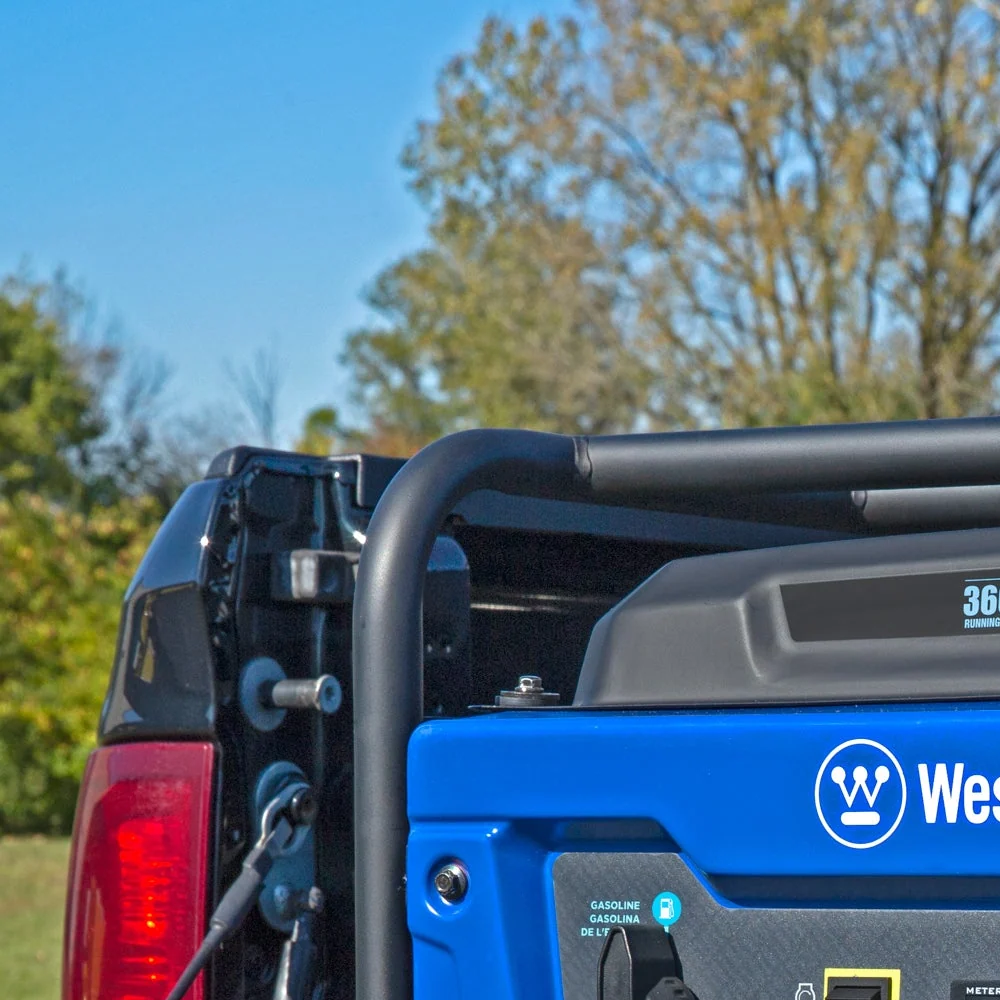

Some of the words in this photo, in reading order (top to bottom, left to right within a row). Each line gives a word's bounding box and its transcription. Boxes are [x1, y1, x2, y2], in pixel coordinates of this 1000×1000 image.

[964, 618, 1000, 629] RUNNING
[590, 900, 640, 910] GASOLINE
[589, 914, 640, 924] GASOLINA
[581, 928, 593, 937] DE
